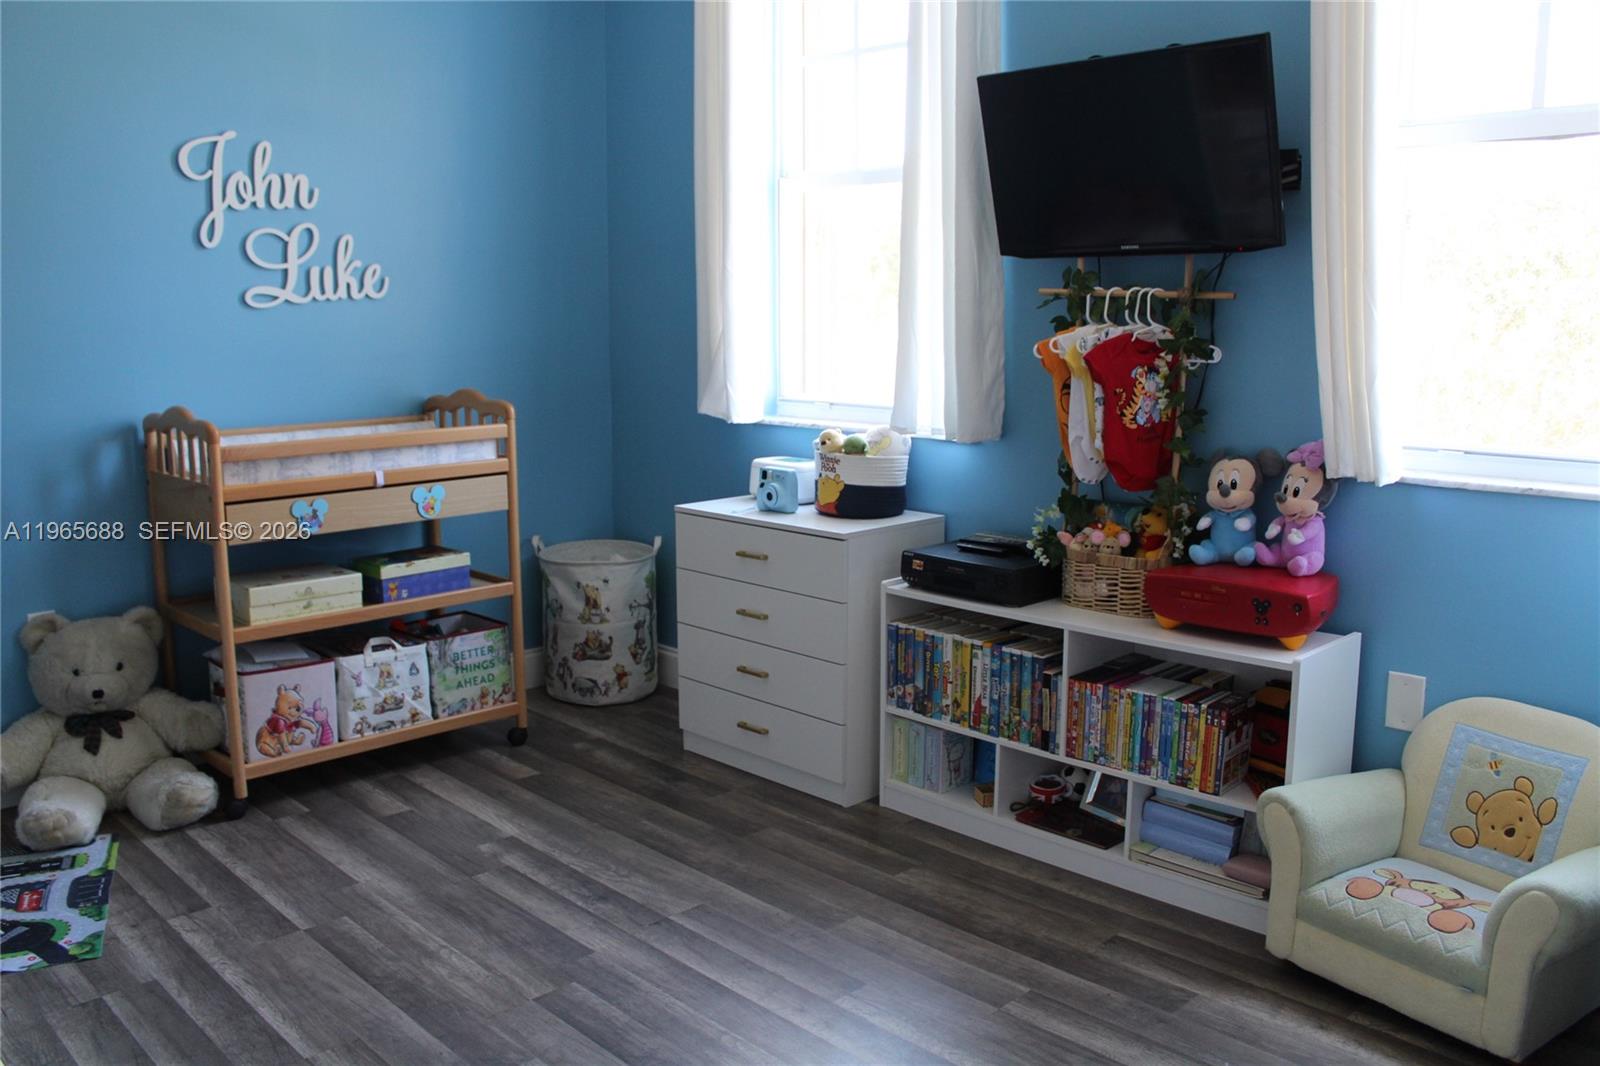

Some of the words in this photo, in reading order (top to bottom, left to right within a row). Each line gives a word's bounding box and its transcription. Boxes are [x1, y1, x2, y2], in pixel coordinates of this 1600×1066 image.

[176, 129, 319, 249] John
[244, 221, 390, 309] Luke
[453, 645, 494, 662] BETTER
[455, 659, 496, 676] THINGS
[455, 673, 495, 690] AHEAD
